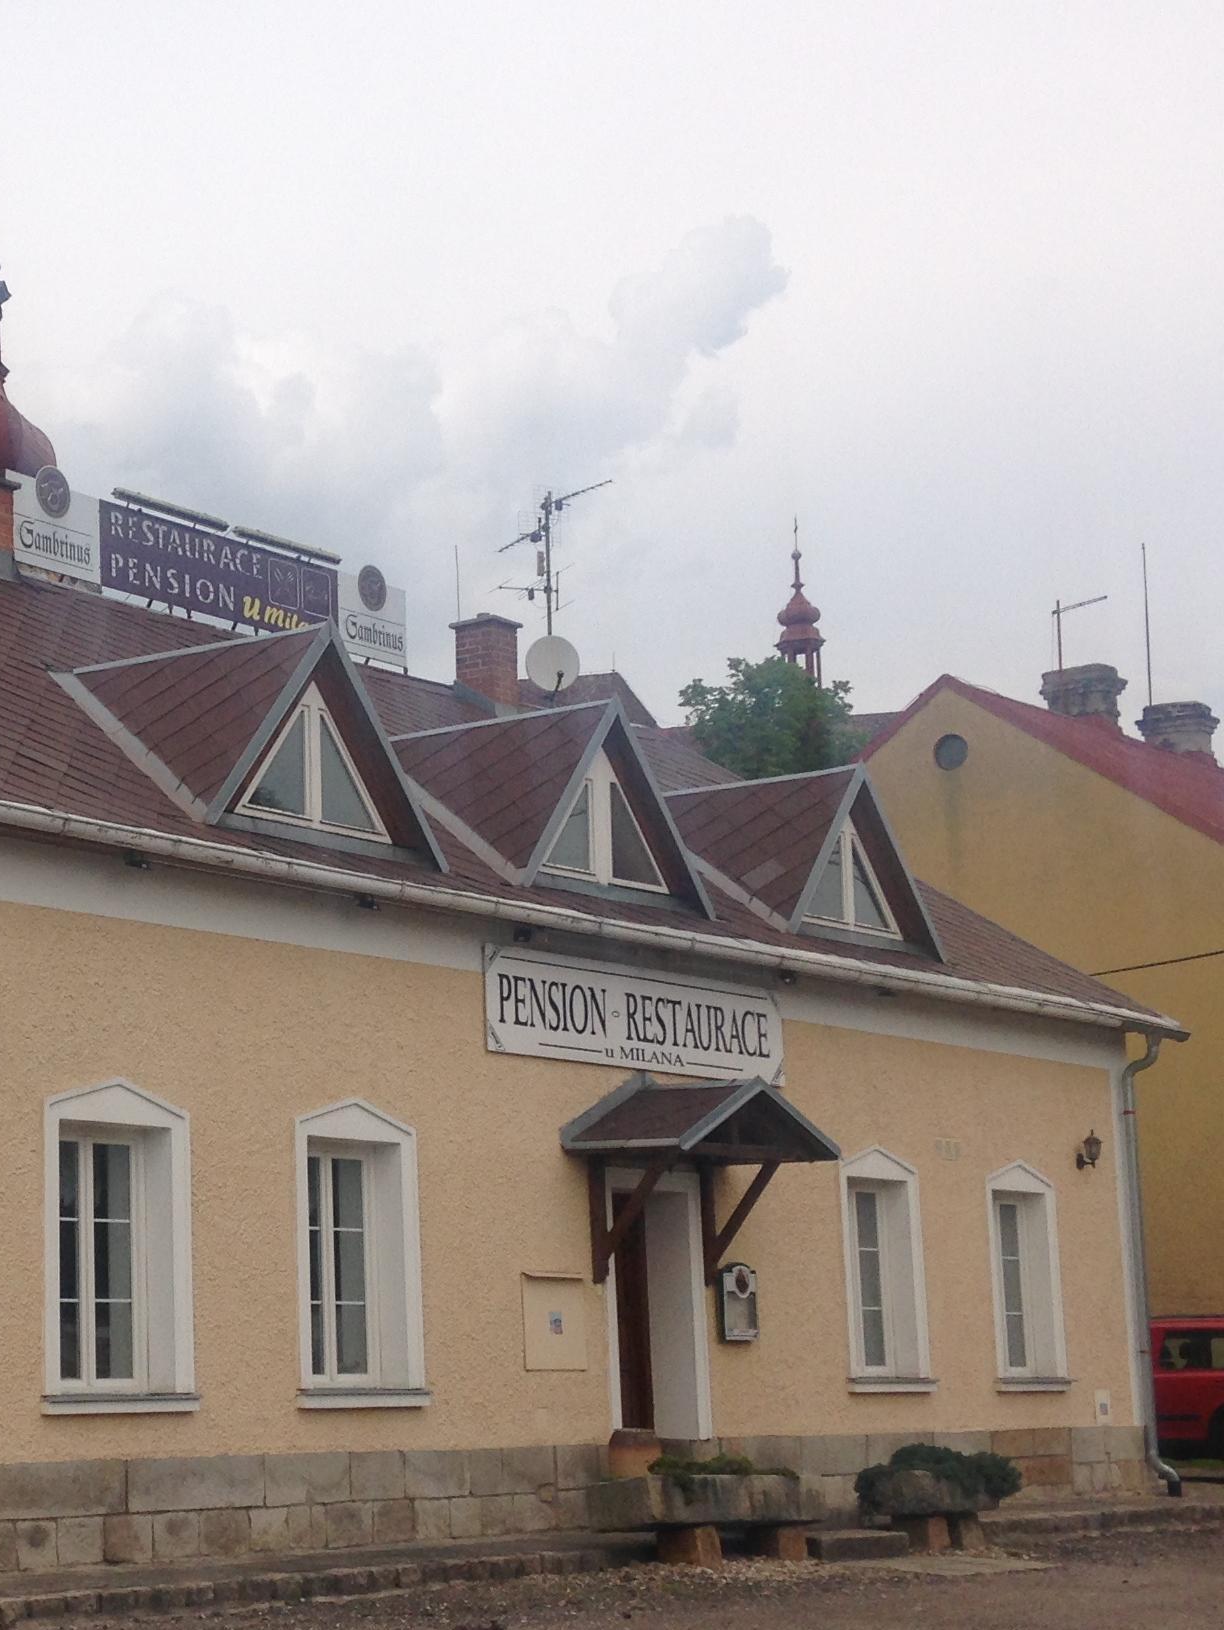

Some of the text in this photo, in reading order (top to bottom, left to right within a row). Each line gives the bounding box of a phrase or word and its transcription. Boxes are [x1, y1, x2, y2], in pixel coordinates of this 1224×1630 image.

[19, 520, 91, 565] Gambrinus
[109, 511, 264, 580] RESTAURACE
[110, 553, 236, 611] PENSION
[345, 613, 404, 652] Gambrinus
[497, 973, 771, 1059] PENSION RESTAURACE
[620, 1046, 685, 1068] MILANA
